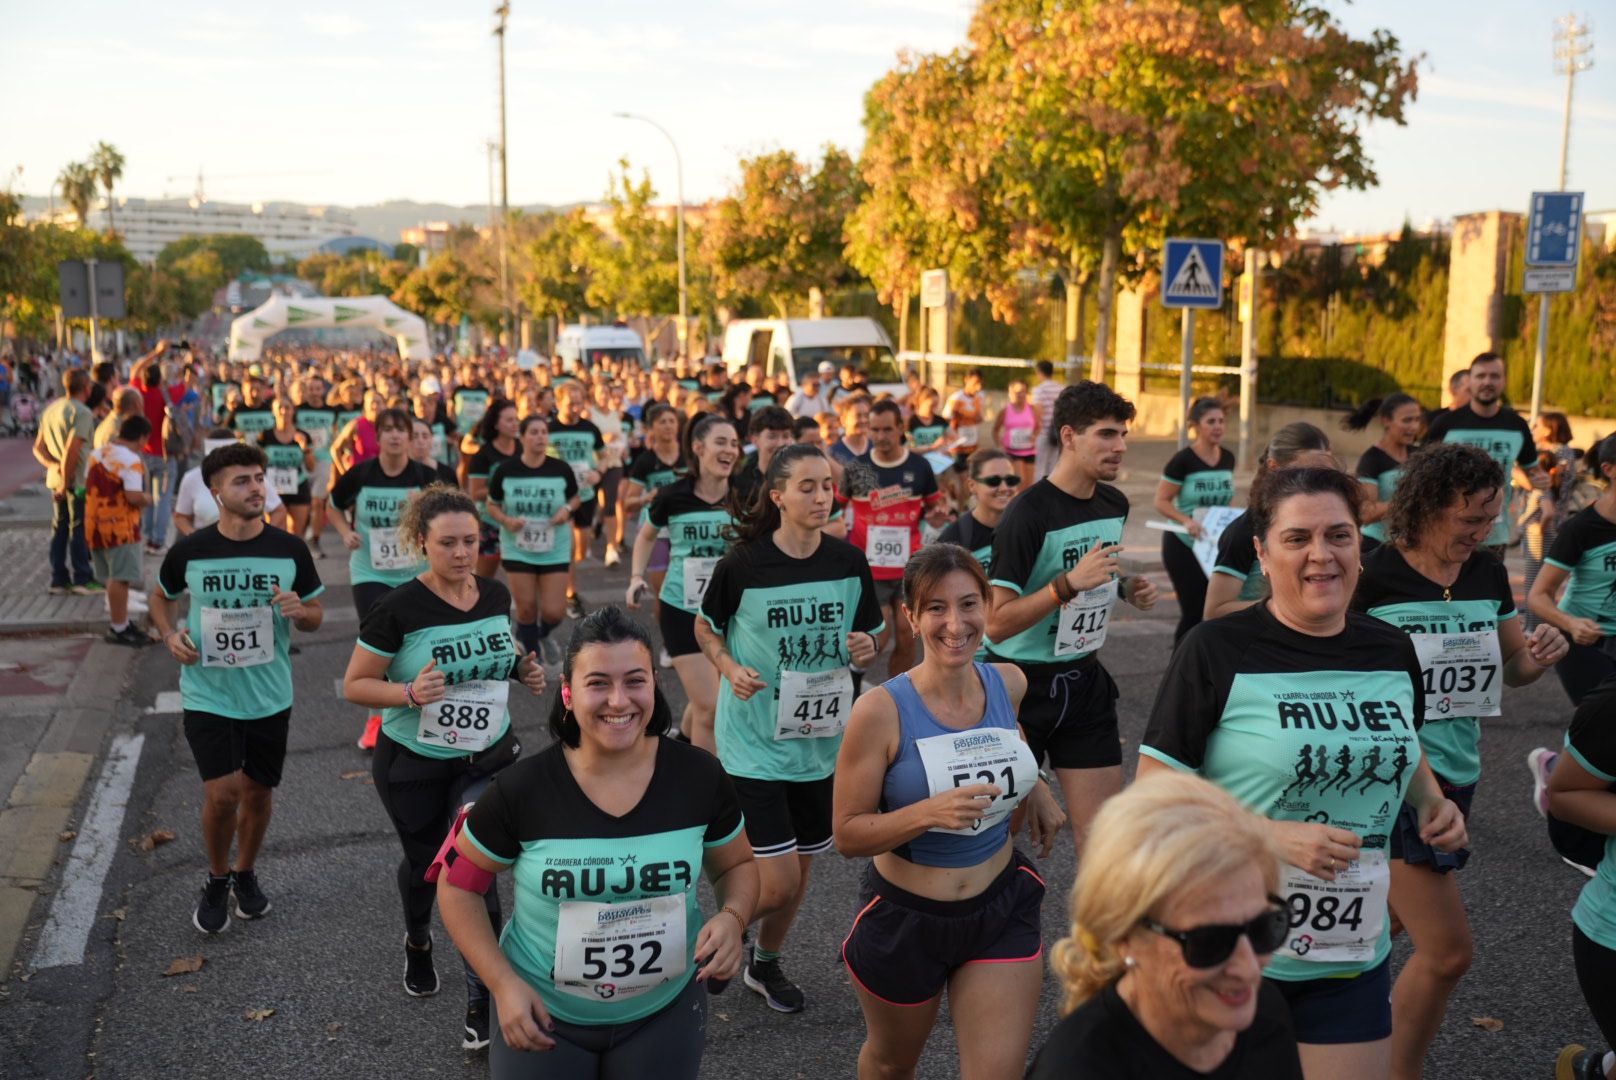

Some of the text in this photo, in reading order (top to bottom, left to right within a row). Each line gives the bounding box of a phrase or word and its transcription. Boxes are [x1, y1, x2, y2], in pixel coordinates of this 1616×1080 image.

[875, 542, 902, 556] 990
[203, 574, 280, 592] MUJER
[768, 602, 844, 628] MUJER
[216, 631, 260, 651] 961
[432, 632, 513, 665] MUJER
[1422, 665, 1496, 694] 1037
[438, 704, 490, 730] 888
[794, 697, 840, 721] 414
[1278, 701, 1409, 731] MUJER
[554, 858, 581, 866] CARRERA
[583, 856, 614, 866] CÓRDOBA
[542, 860, 691, 898] MUJER
[1288, 893, 1363, 931] 984
[583, 940, 662, 980] 532
